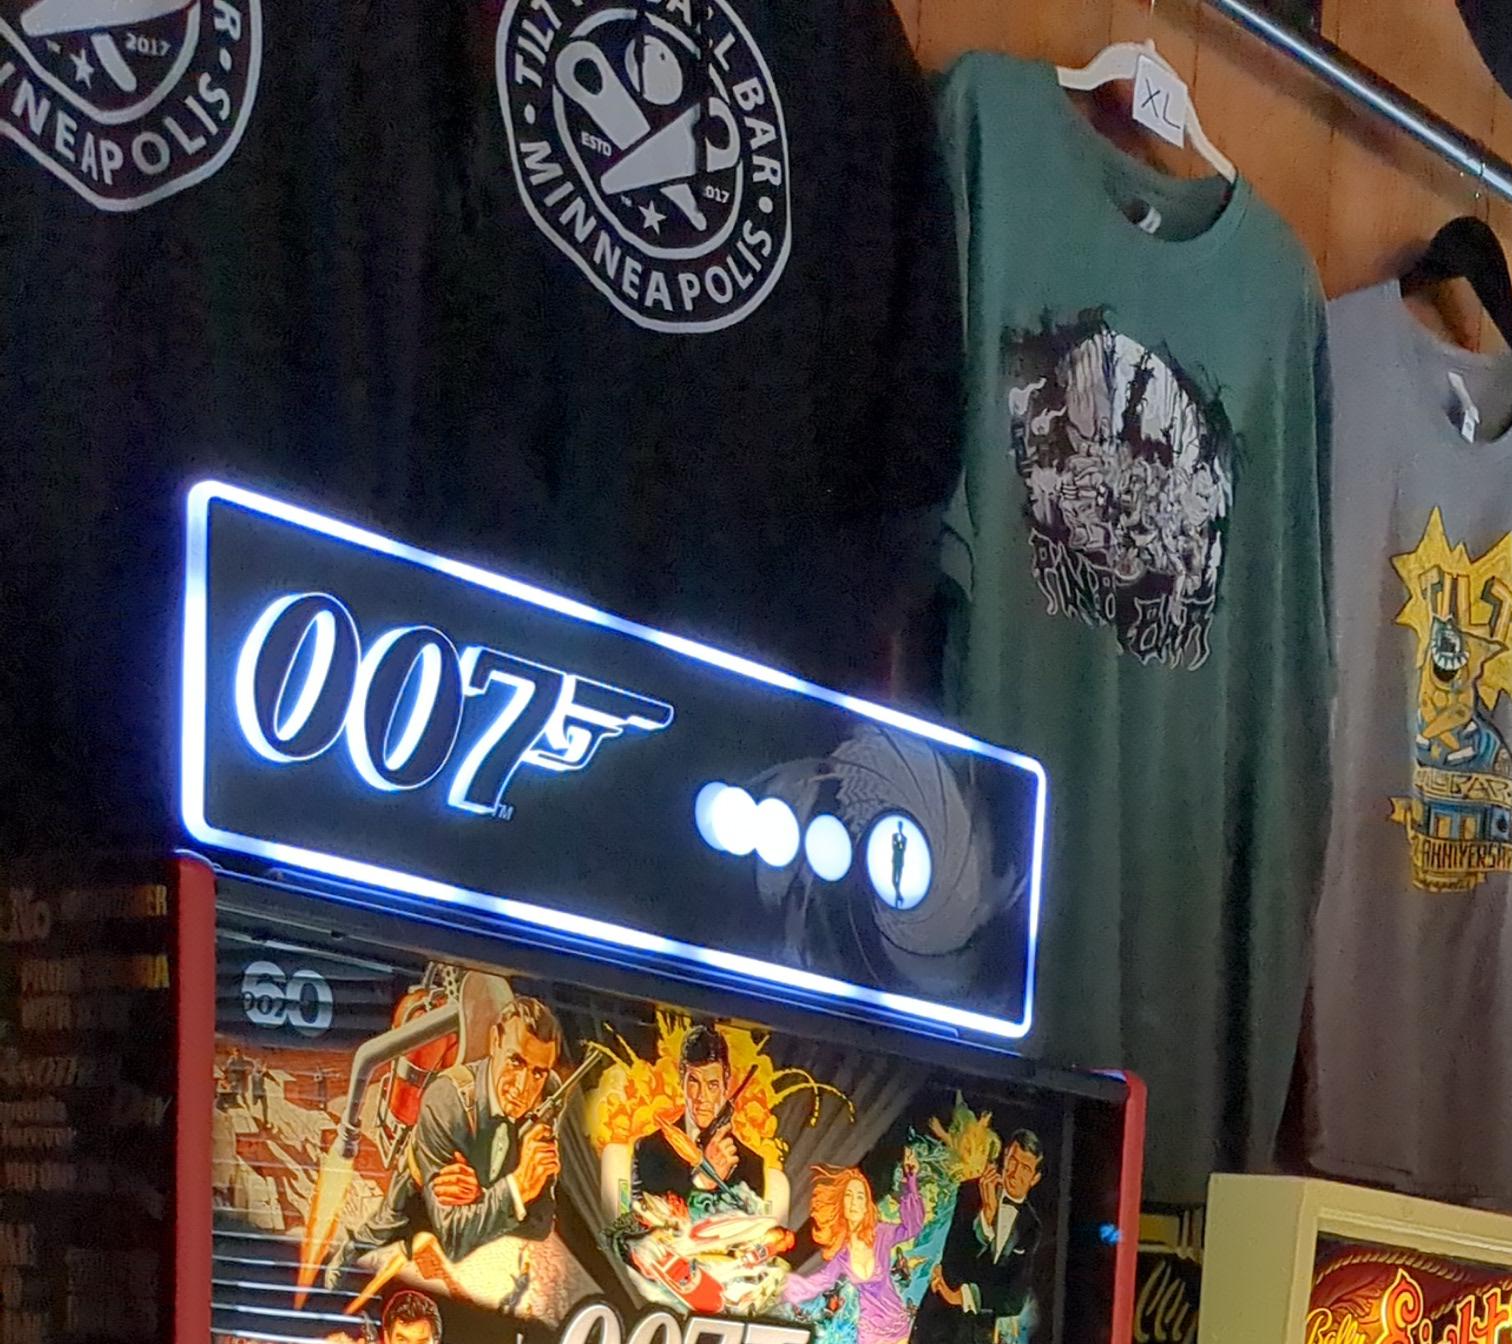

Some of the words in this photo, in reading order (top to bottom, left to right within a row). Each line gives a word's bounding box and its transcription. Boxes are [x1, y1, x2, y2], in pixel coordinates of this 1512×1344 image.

[125, 32, 171, 57] 2017
[732, 76, 783, 187] BAR
[1141, 78, 1181, 130] XL
[581, 131, 612, 157] ESTD
[519, 140, 773, 312] MINNEAPOLIS
[705, 184, 730, 204] 017
[235, 591, 563, 816] 007
[242, 961, 333, 1037] 60
